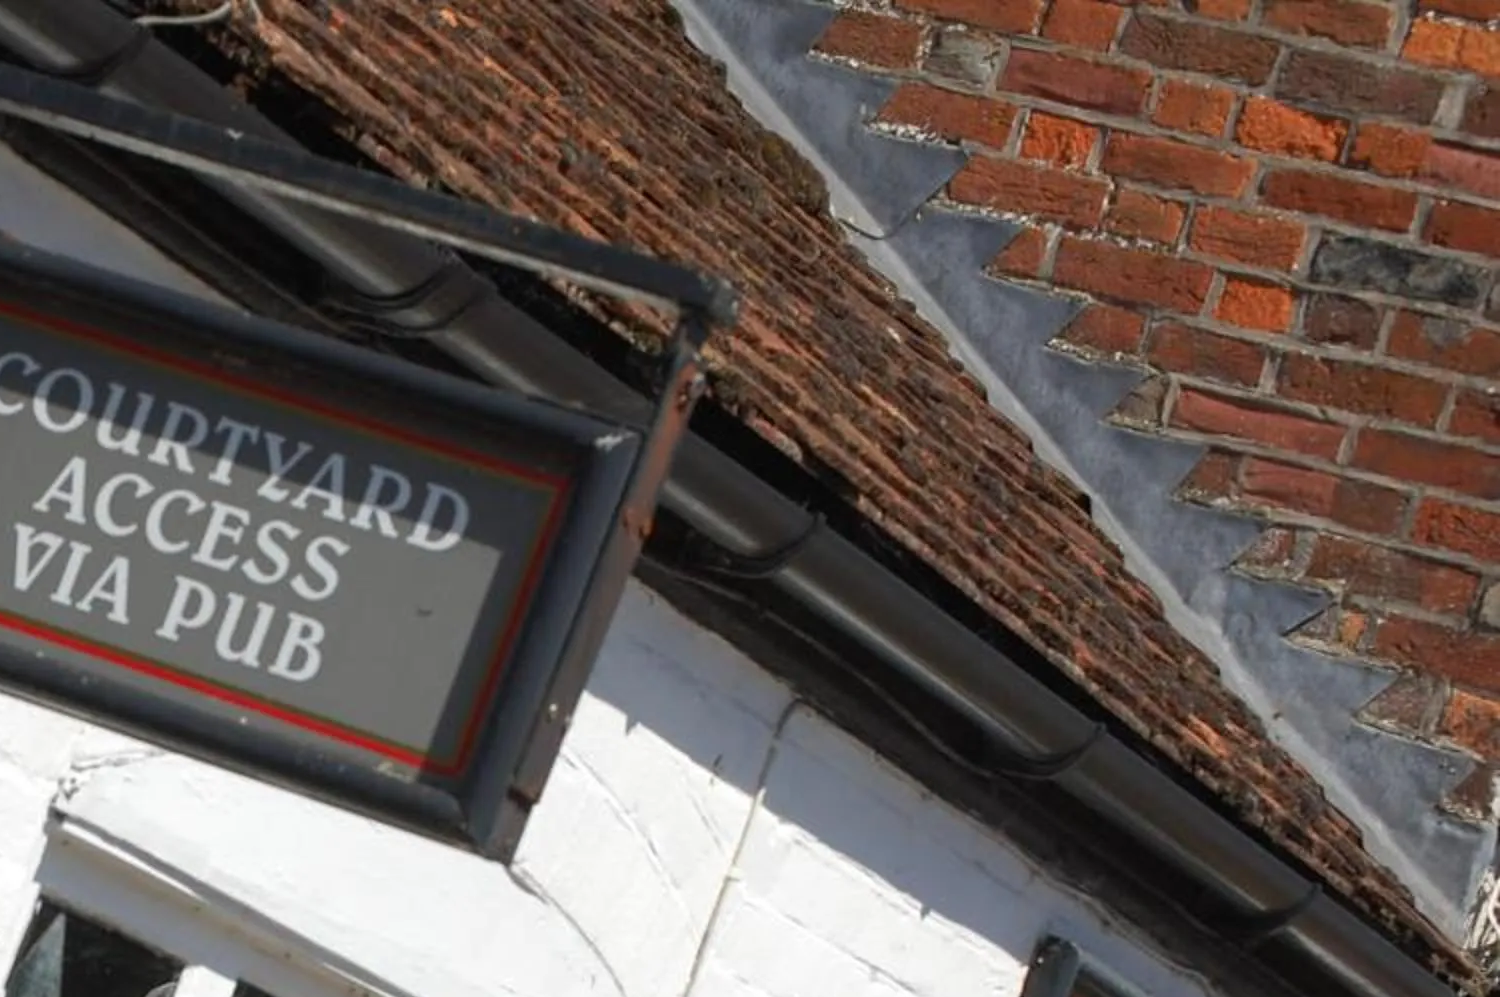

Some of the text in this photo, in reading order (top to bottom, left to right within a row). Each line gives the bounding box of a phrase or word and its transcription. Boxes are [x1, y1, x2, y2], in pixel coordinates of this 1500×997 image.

[13, 523, 326, 682] VIA PUB
[33, 456, 351, 601] ACCESS
